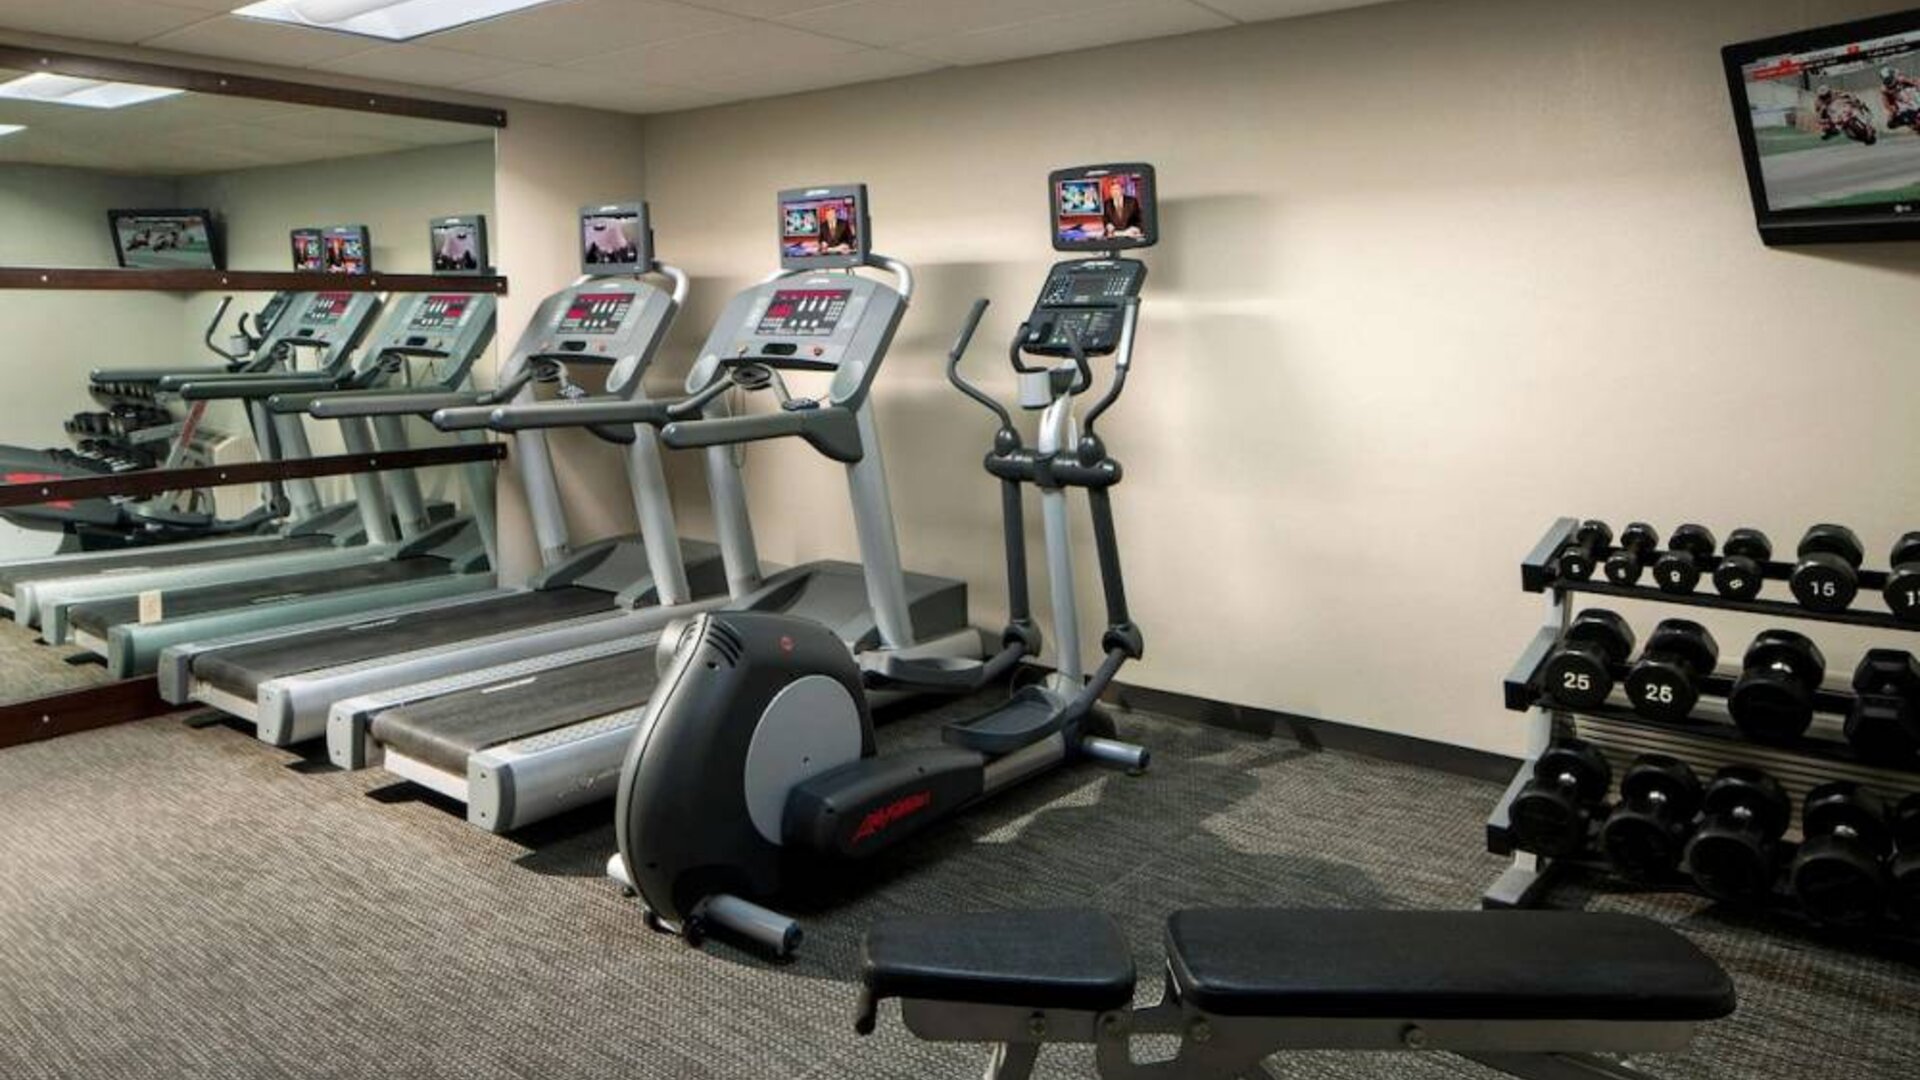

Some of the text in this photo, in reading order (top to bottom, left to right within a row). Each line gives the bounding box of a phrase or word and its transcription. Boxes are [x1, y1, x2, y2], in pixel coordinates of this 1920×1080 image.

[1810, 581, 1836, 597] 15
[1906, 590, 1920, 606] 1
[1563, 671, 1590, 690] 25
[1645, 683, 1673, 703] 25
